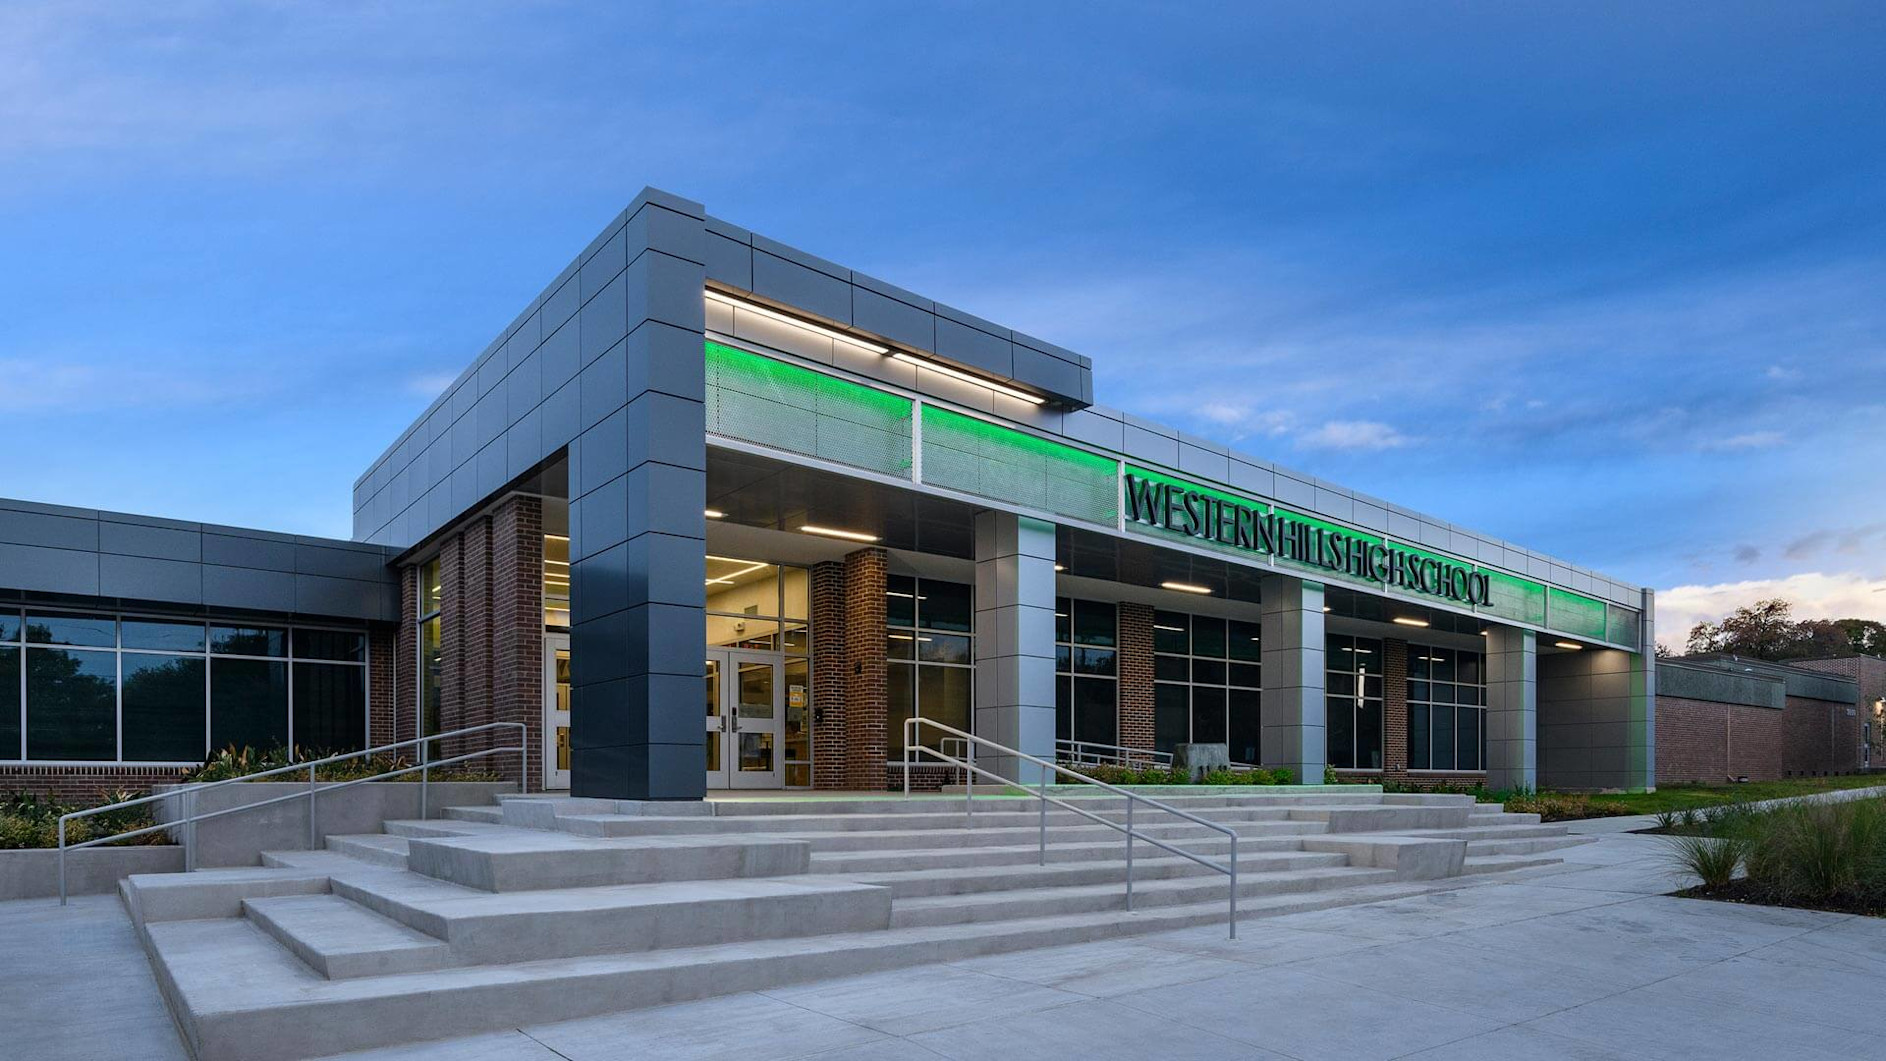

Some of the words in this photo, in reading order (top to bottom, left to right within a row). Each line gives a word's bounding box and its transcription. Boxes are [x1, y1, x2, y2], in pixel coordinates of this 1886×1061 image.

[1125, 474, 1276, 554] WESTERN
[1277, 517, 1343, 570] HILLS
[1345, 537, 1405, 586] HIGH
[1407, 554, 1494, 607] SCHOOL
